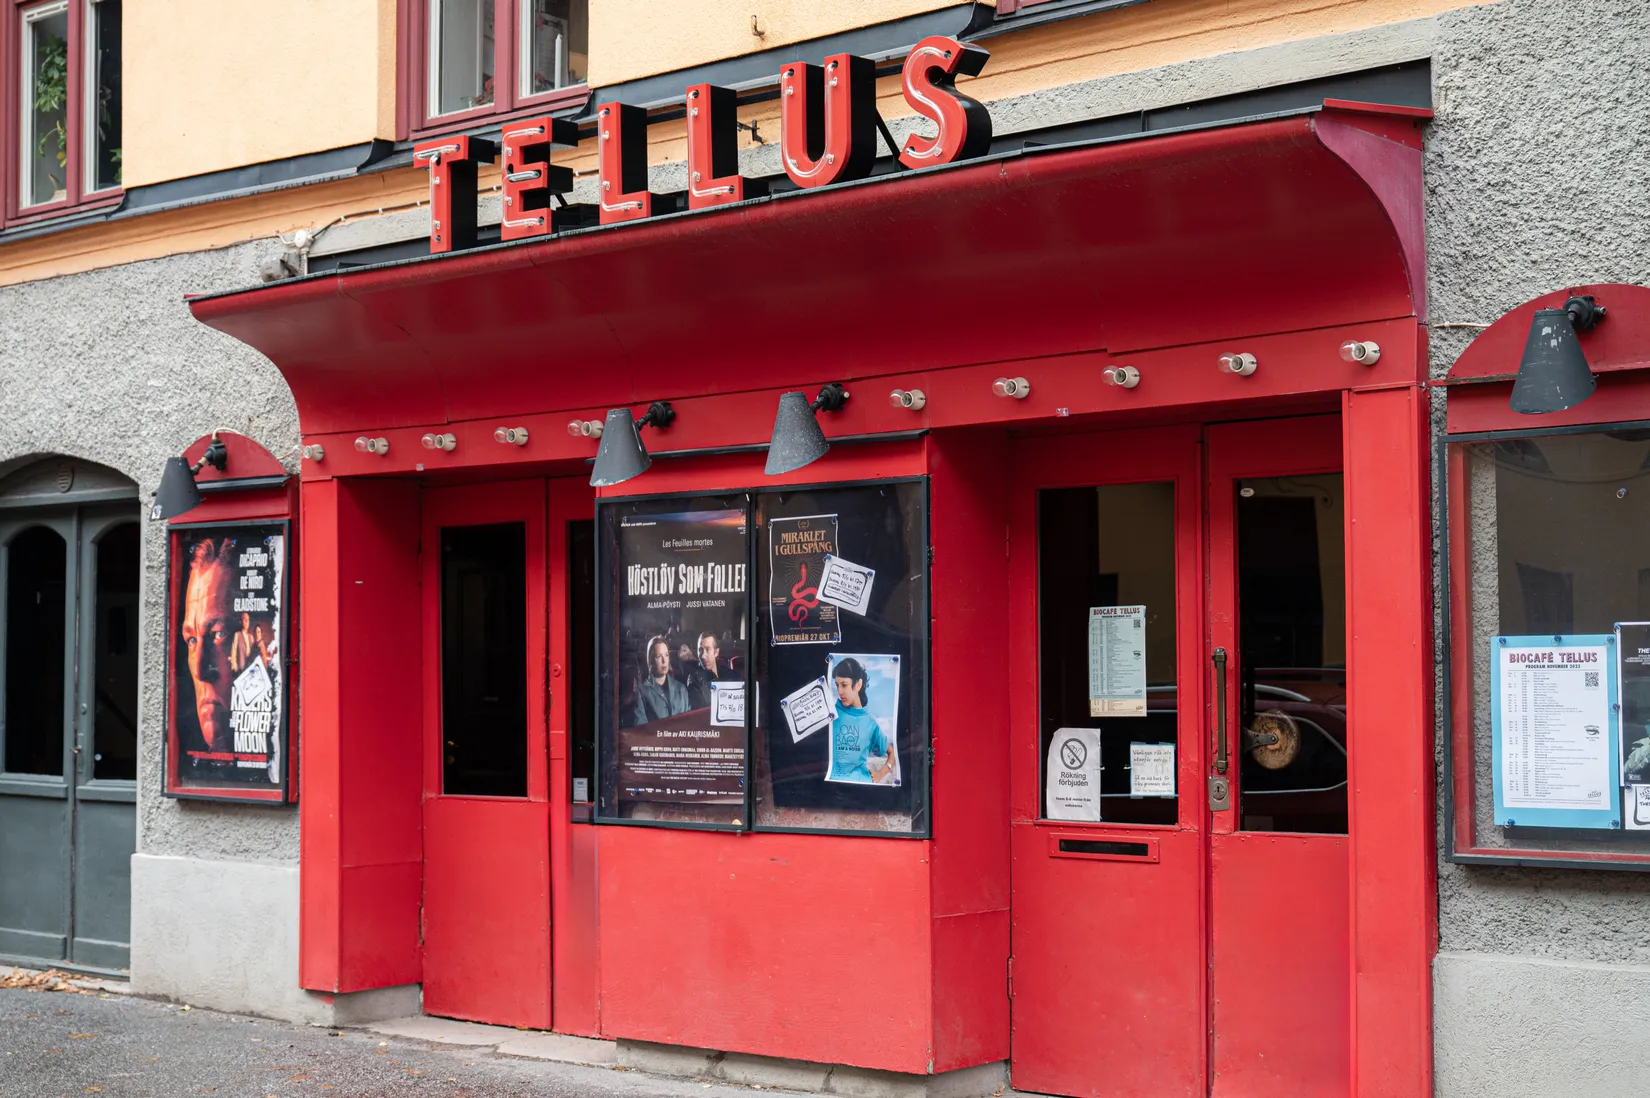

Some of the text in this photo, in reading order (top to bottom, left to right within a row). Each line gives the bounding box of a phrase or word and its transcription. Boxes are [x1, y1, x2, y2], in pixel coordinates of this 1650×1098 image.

[413, 35, 990, 253] TELLUS
[662, 538, 713, 548] Les Feuilles mortes
[781, 530, 826, 544] MIRAKLET
[775, 541, 832, 556] I GULLSPÅNG
[628, 562, 676, 596] HÖSTLÖV
[678, 563, 704, 594] SOM
[1509, 652, 1598, 663] BIOCAFÉ TELLUS
[235, 712, 271, 733] FLOWER
[234, 732, 267, 753] MOON
[1058, 779, 1088, 787] förbjuden
[1060, 772, 1086, 780] Rökning
